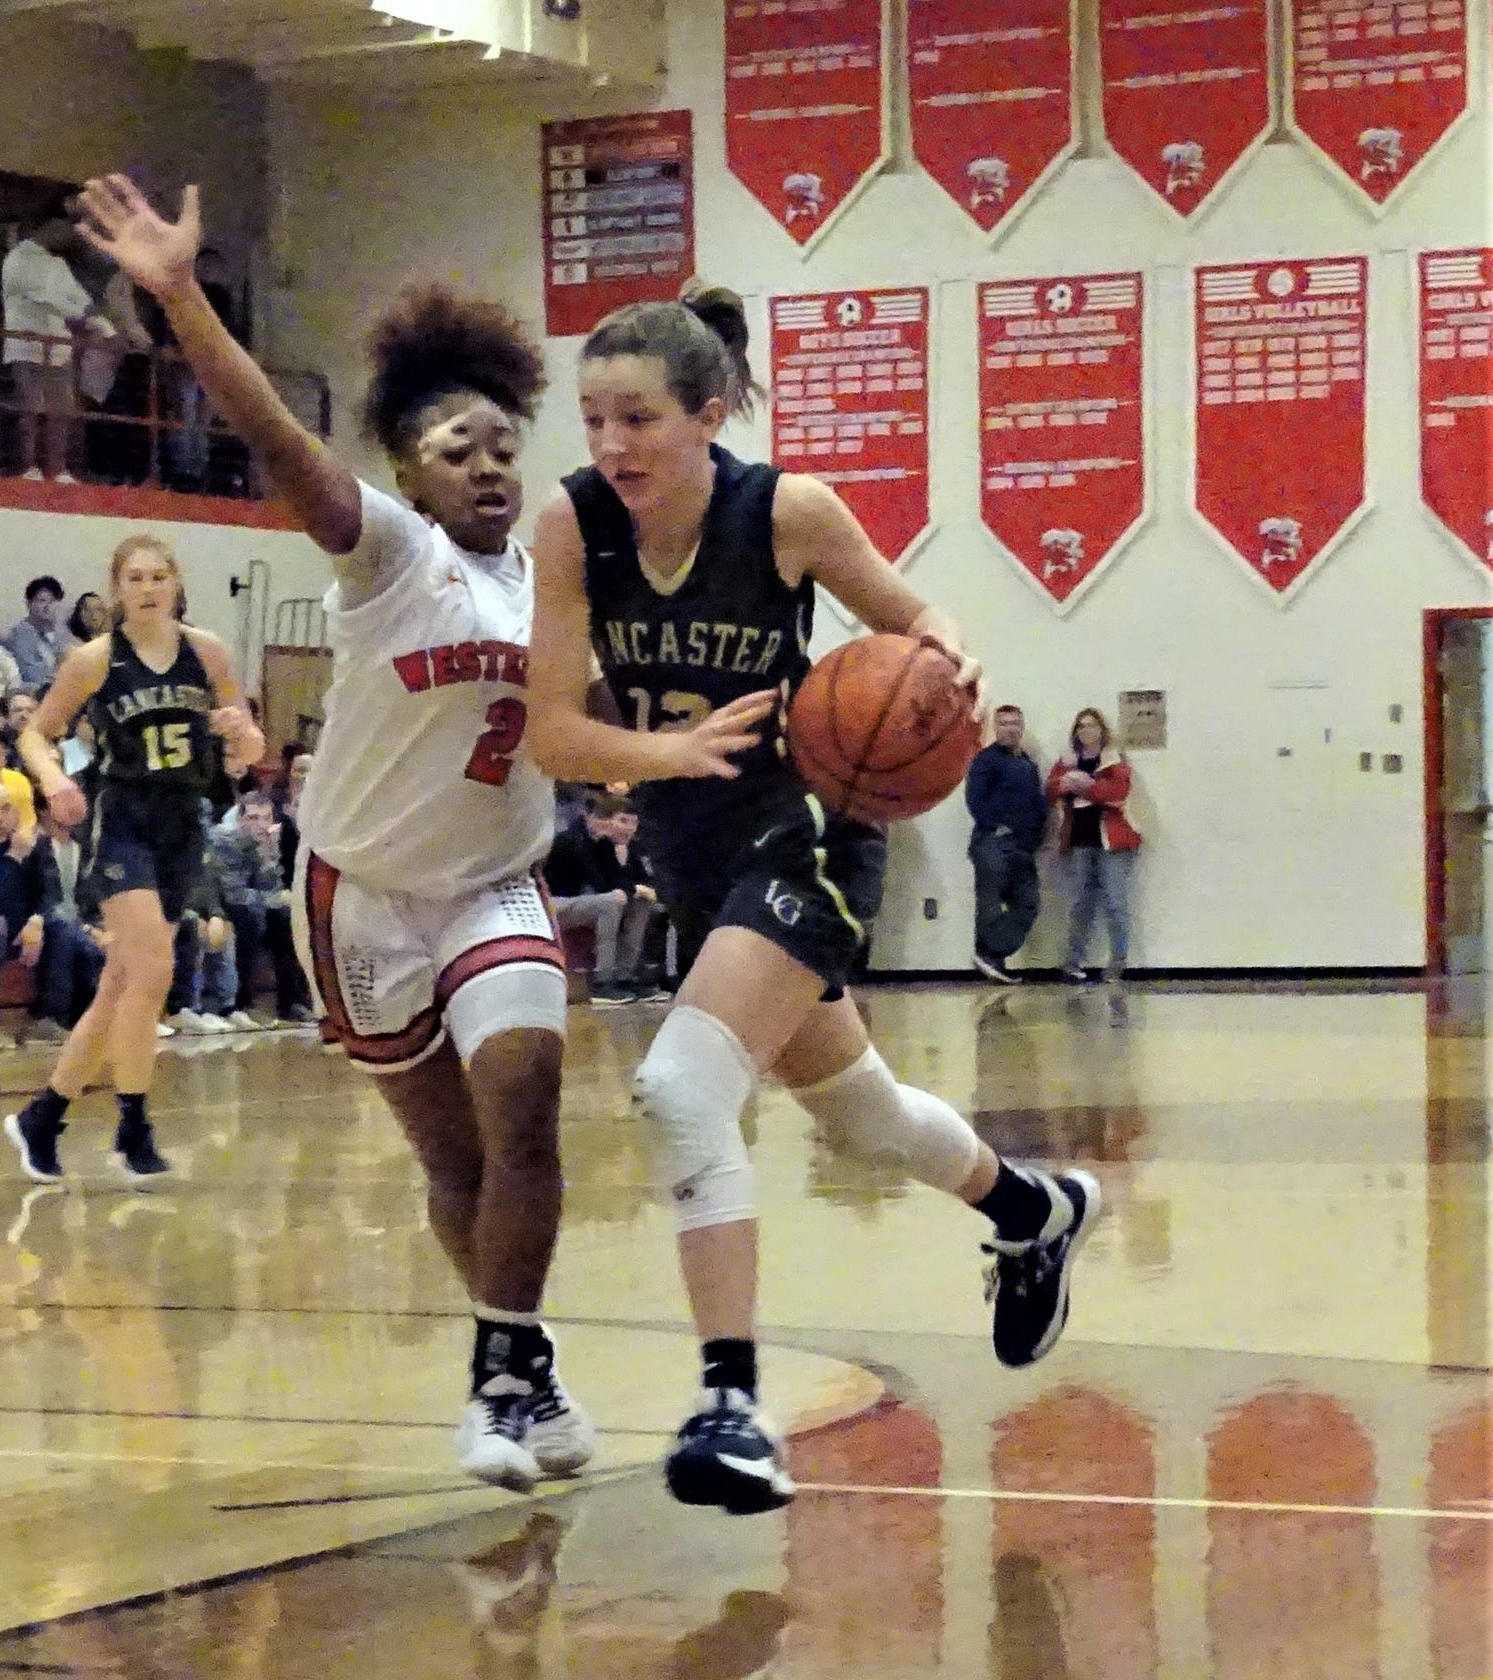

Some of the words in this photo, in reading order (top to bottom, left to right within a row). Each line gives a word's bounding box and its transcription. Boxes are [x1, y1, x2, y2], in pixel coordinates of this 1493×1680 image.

[1254, 299, 1360, 320] VOLLEYBALL
[142, 723, 193, 771] 15
[464, 696, 528, 787] 2
